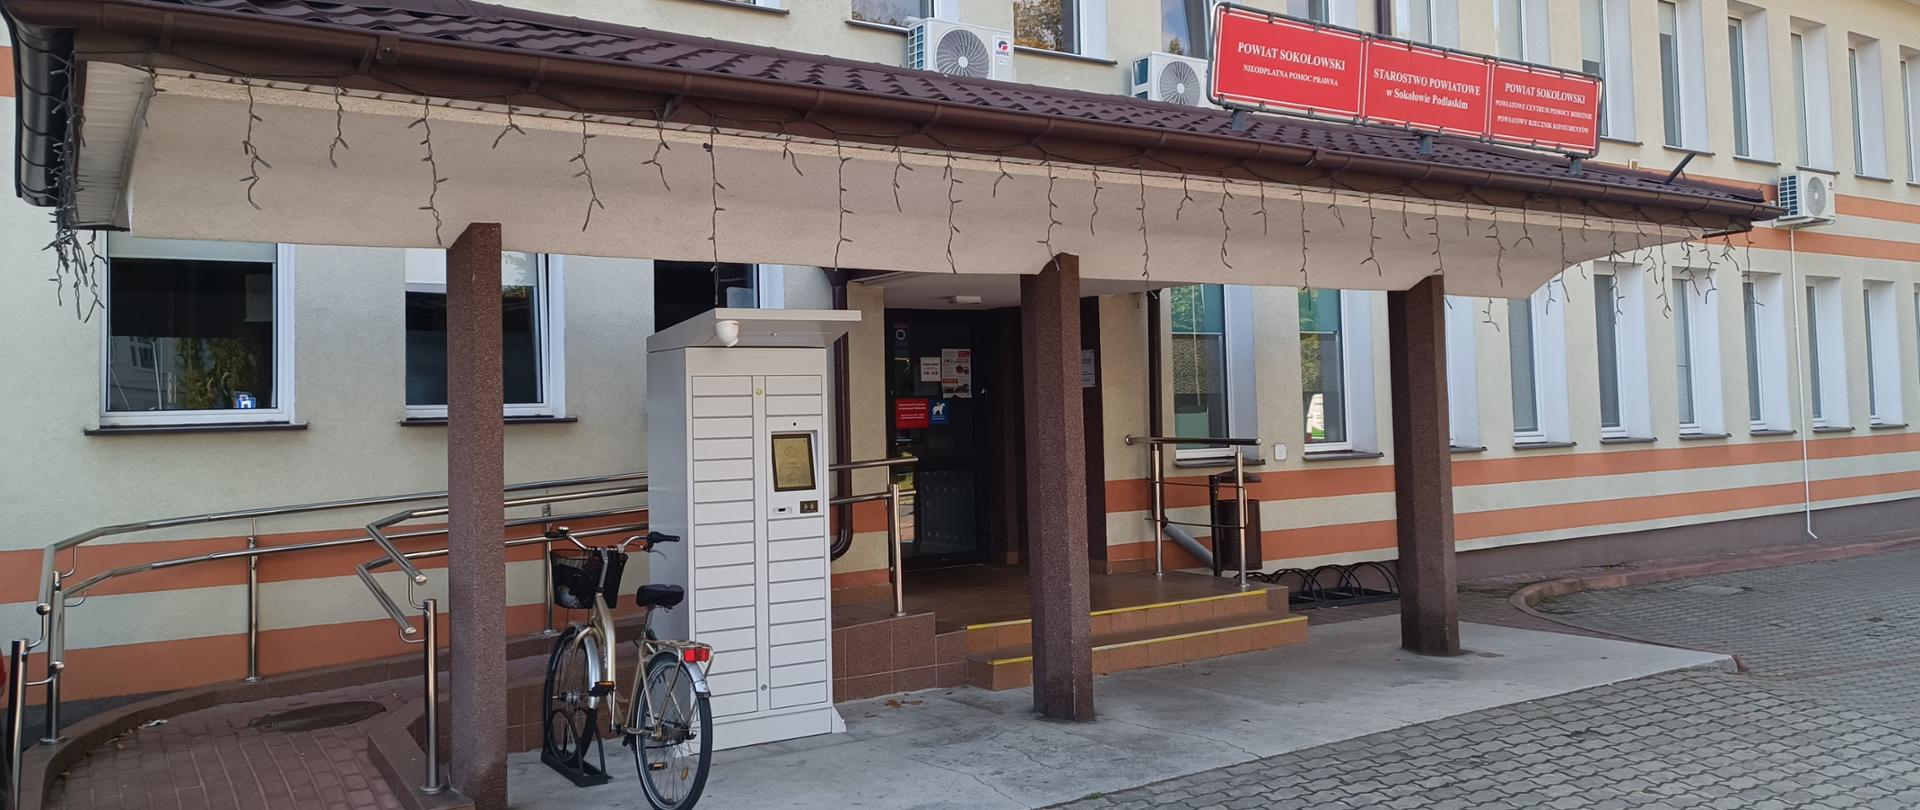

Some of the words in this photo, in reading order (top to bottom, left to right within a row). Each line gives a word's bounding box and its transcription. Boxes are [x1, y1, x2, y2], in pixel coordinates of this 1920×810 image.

[1238, 42, 1278, 58] POWIAT
[1288, 71, 1312, 82] POMOC
[1313, 76, 1339, 86] PRAWNA
[1374, 68, 1428, 86] STAROSTWO
[1429, 78, 1481, 96] POWIATOWE
[1505, 82, 1536, 97] POWIAT
[1386, 89, 1393, 97] w
[1432, 95, 1468, 109] Podlaskim
[1526, 103, 1550, 113] CENTRUM
